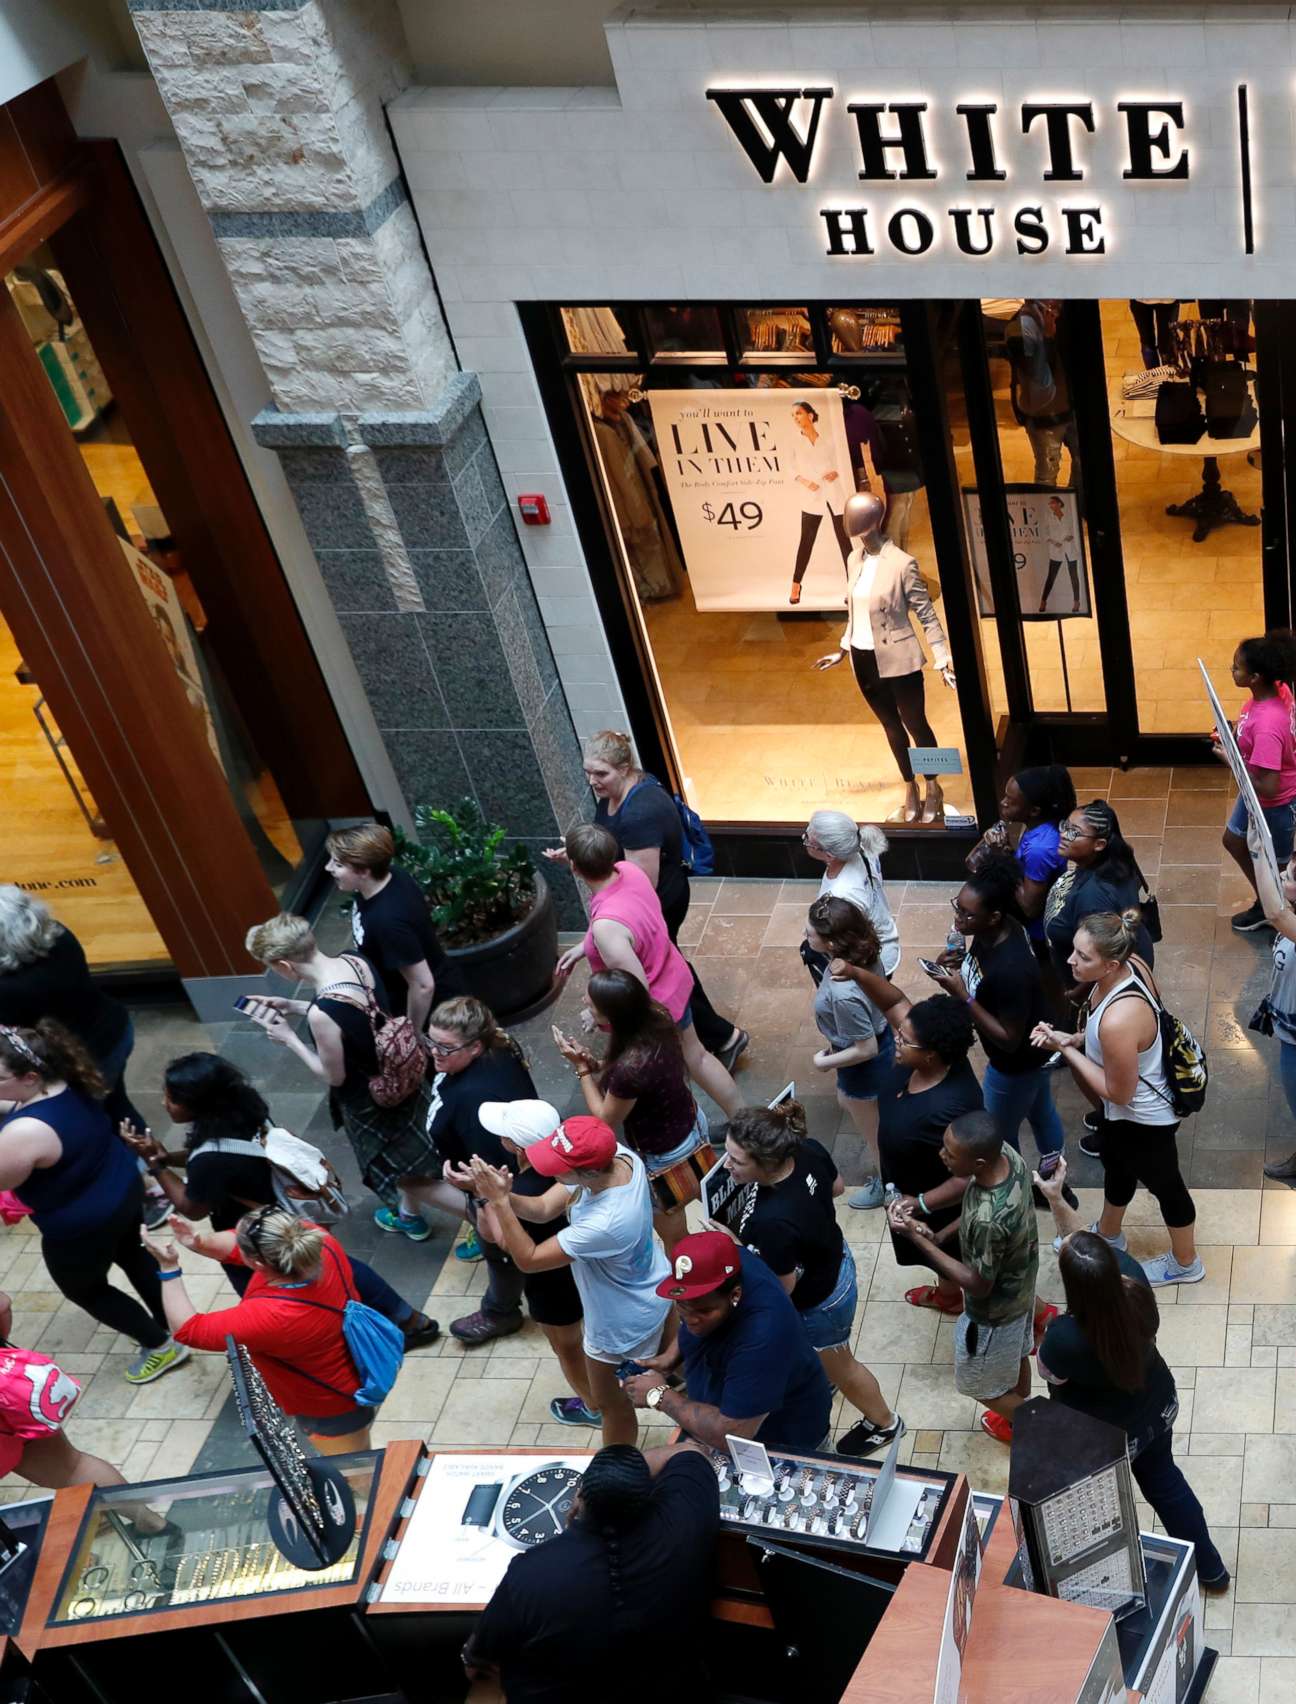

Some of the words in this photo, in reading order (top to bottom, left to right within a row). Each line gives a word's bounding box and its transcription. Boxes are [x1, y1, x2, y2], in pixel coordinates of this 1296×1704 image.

[706, 87, 1189, 183] WHITE
[820, 207, 1106, 255] HOUSE
[679, 408, 711, 422] you'll
[713, 409, 741, 418] want
[744, 408, 754, 417] to
[671, 421, 777, 455] LIVE
[677, 458, 703, 476] IN
[709, 456, 781, 474] THEM
[702, 501, 763, 530] $49
[394, 1581, 450, 1595] Brands
[452, 1583, 475, 1595] All
